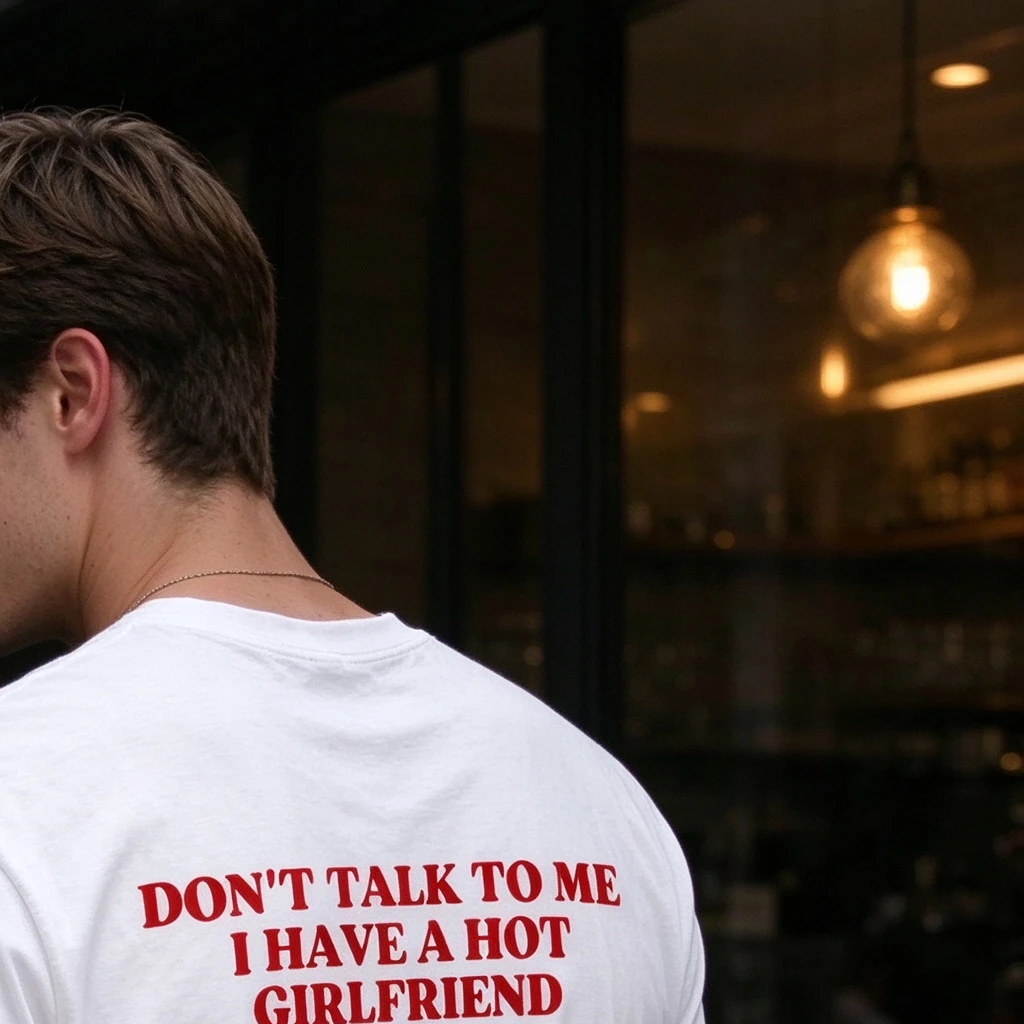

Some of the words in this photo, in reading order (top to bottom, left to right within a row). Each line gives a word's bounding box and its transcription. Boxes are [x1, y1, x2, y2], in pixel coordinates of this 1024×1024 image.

[137, 867, 314, 929] DON'T
[326, 862, 463, 909] TALK
[470, 859, 543, 904] TO
[553, 861, 621, 907] ME
[230, 931, 252, 977] I
[263, 921, 407, 973] HAVE
[417, 919, 455, 964] A
[463, 915, 571, 961] HOT
